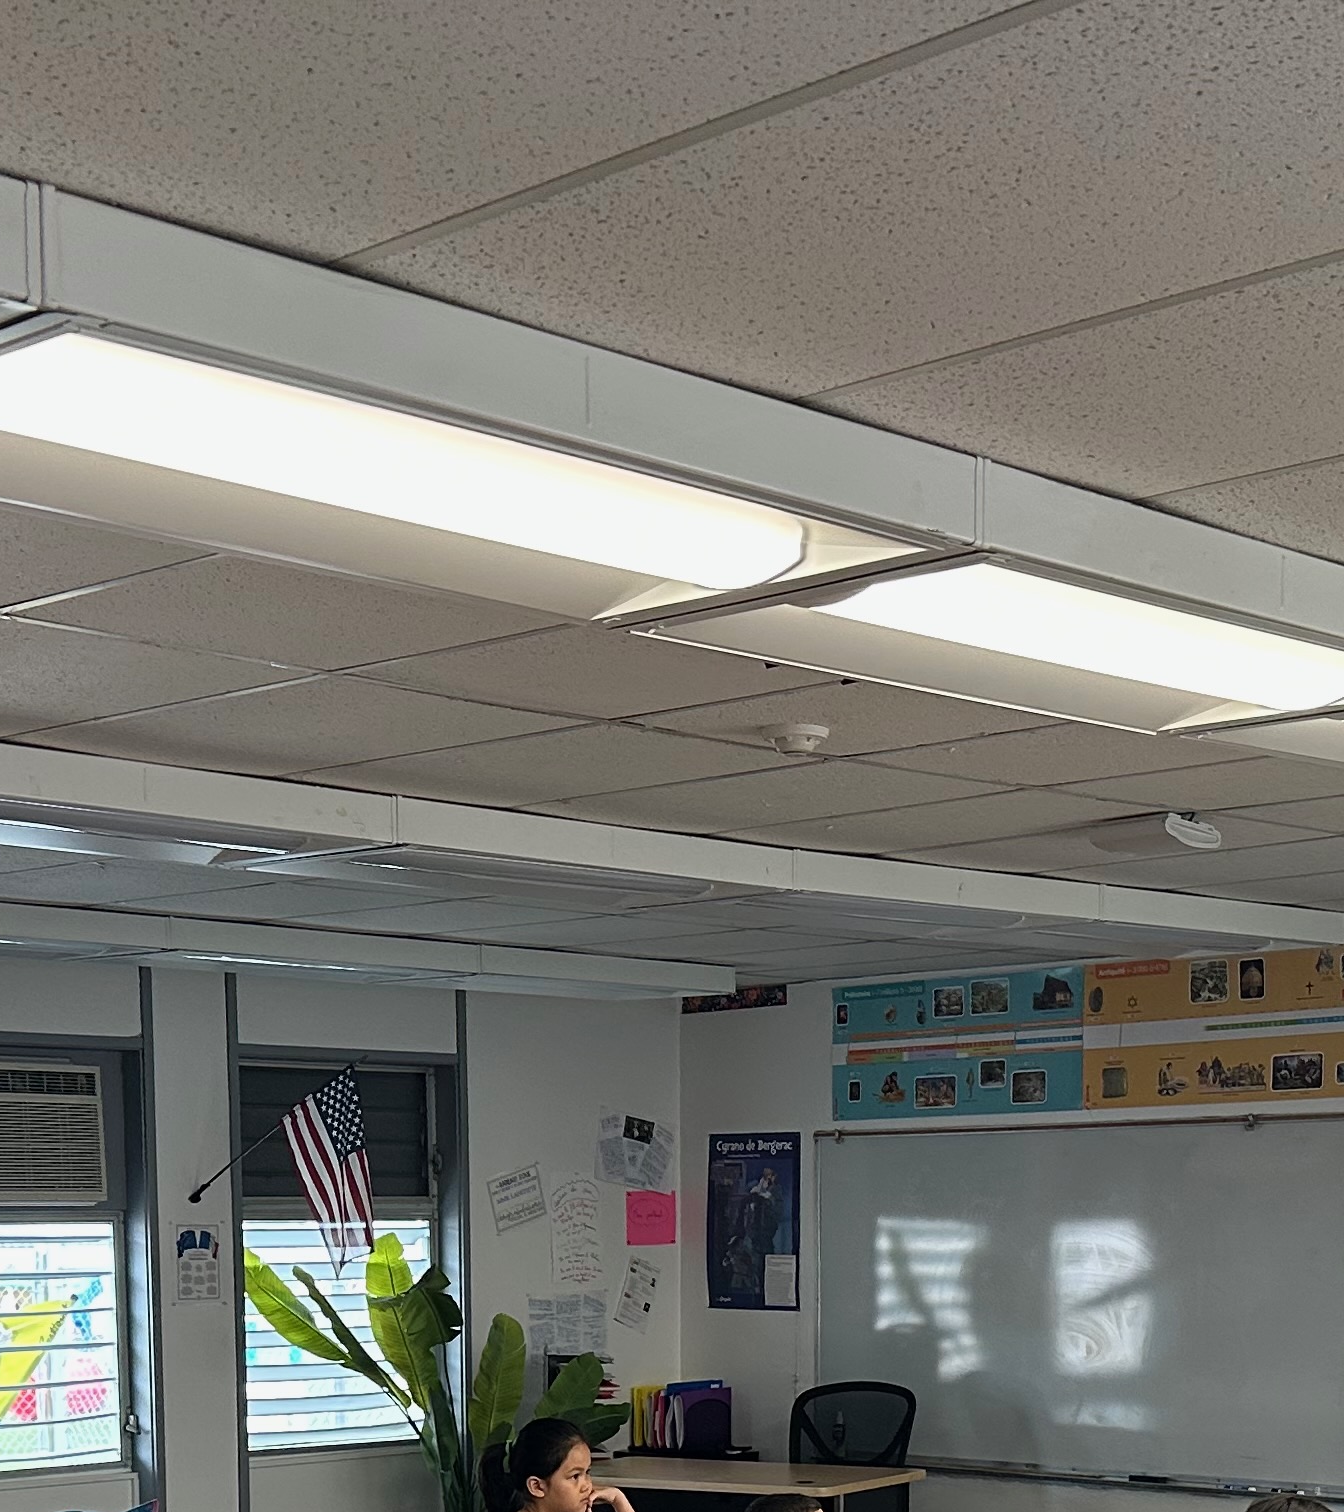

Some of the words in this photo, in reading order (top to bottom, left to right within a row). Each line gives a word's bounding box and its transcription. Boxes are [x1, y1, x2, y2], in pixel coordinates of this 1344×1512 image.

[716, 1140, 745, 1155] Cyrano
[746, 1139, 756, 1151] de
[757, 1139, 793, 1155] Bergerac
